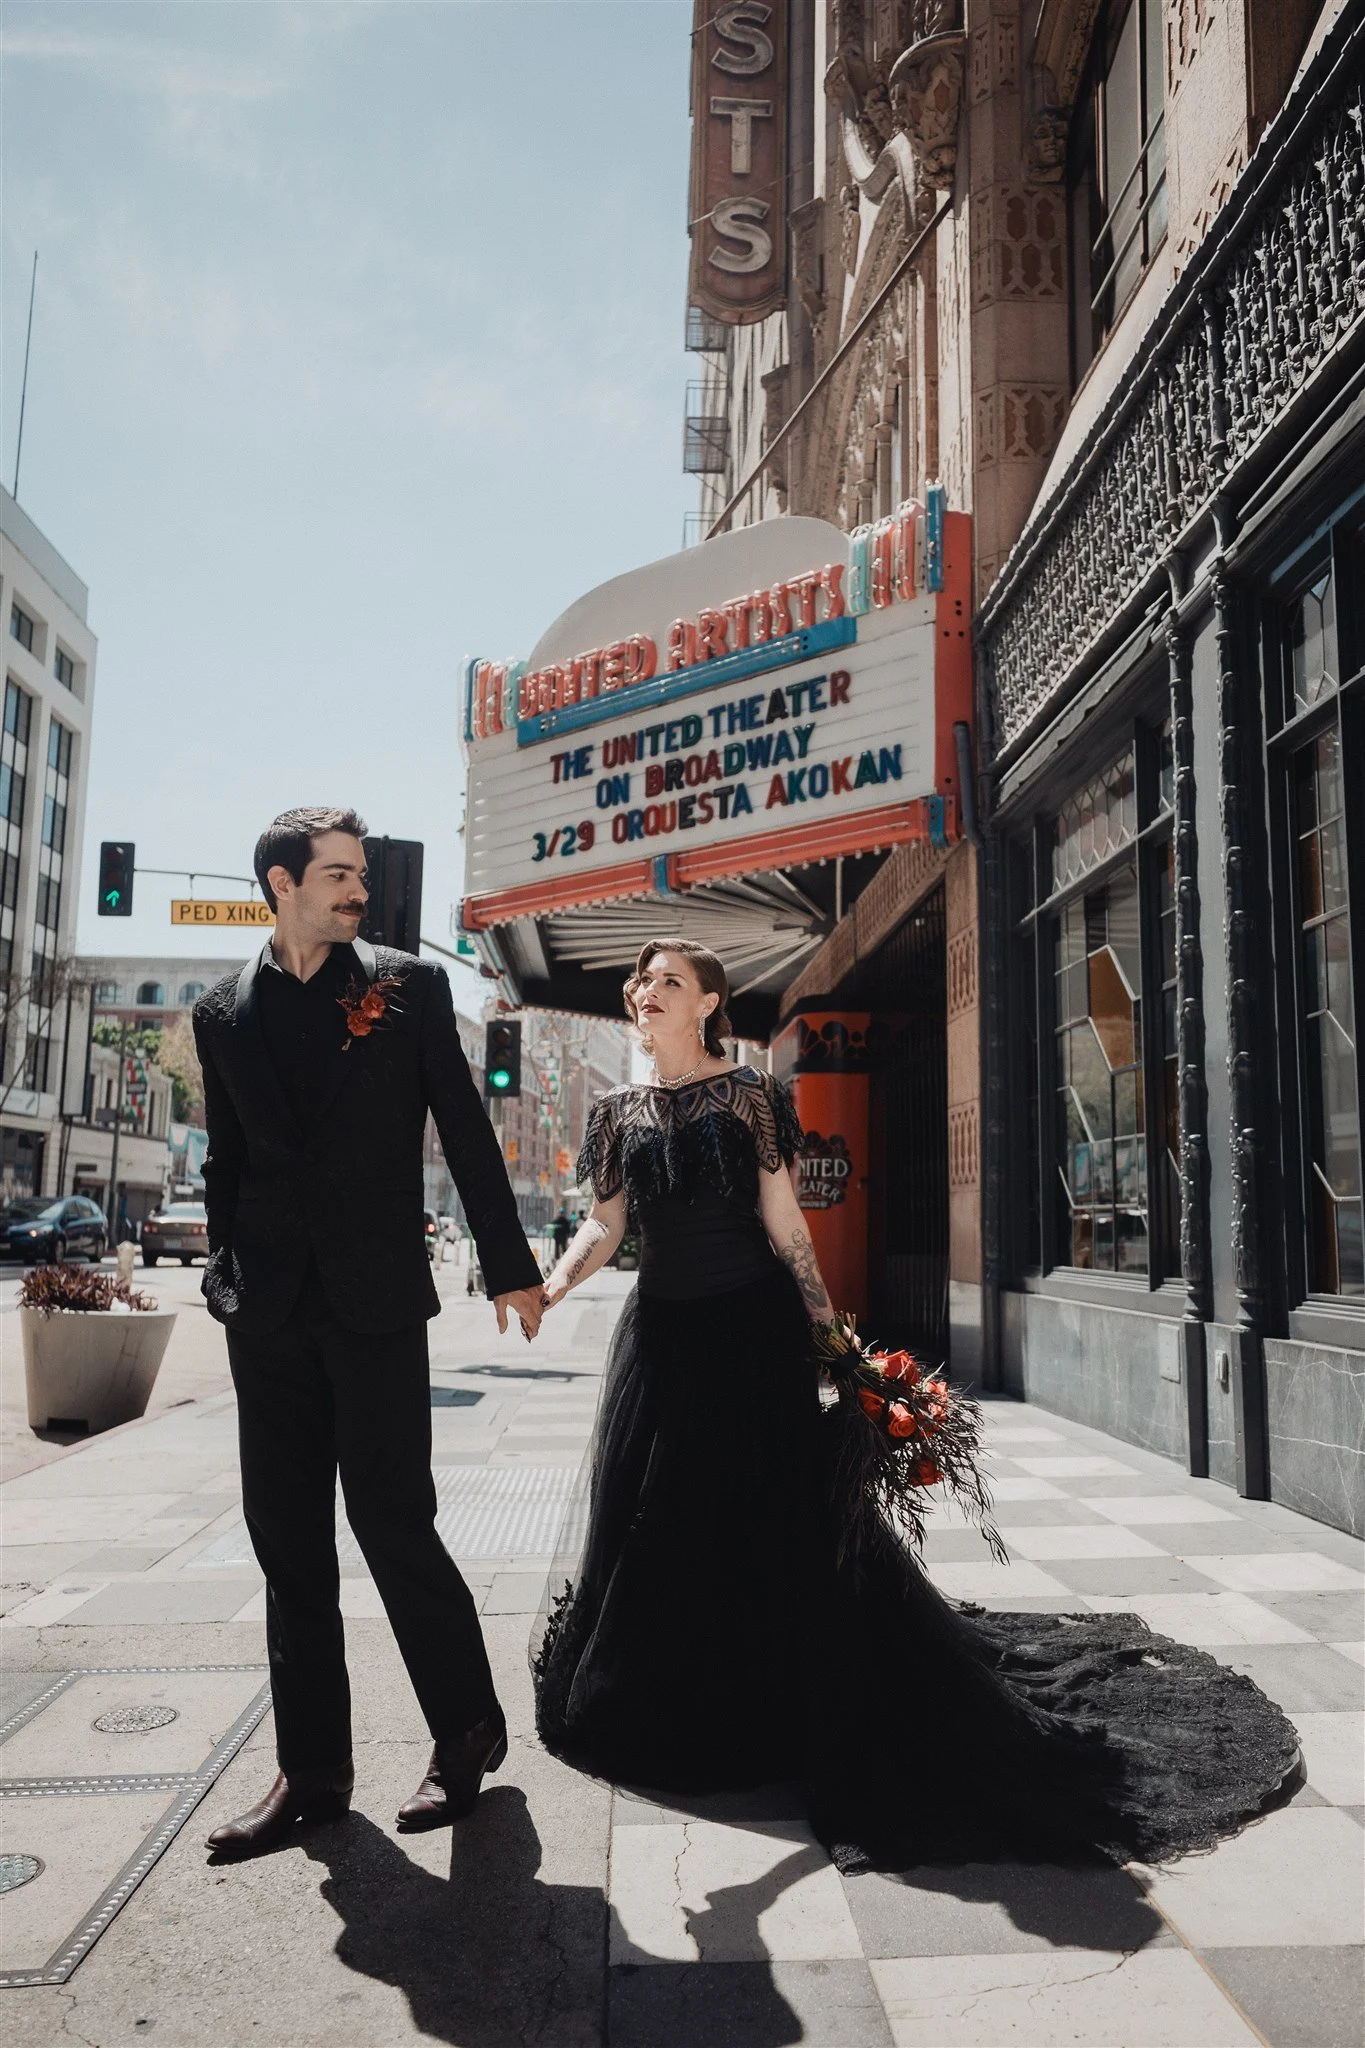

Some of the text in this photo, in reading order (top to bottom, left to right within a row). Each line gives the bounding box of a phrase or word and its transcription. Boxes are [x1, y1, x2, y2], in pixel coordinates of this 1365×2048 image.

[518, 563, 846, 721] UNITED ARTISTS
[550, 670, 851, 784] THE UNITED THEATER
[596, 722, 815, 809] ON BROADWAY
[531, 743, 902, 862] 3/29 ORQUESTA AKOKAN
[180, 904, 270, 922] PED XING
[796, 1157, 849, 1177] NITED
